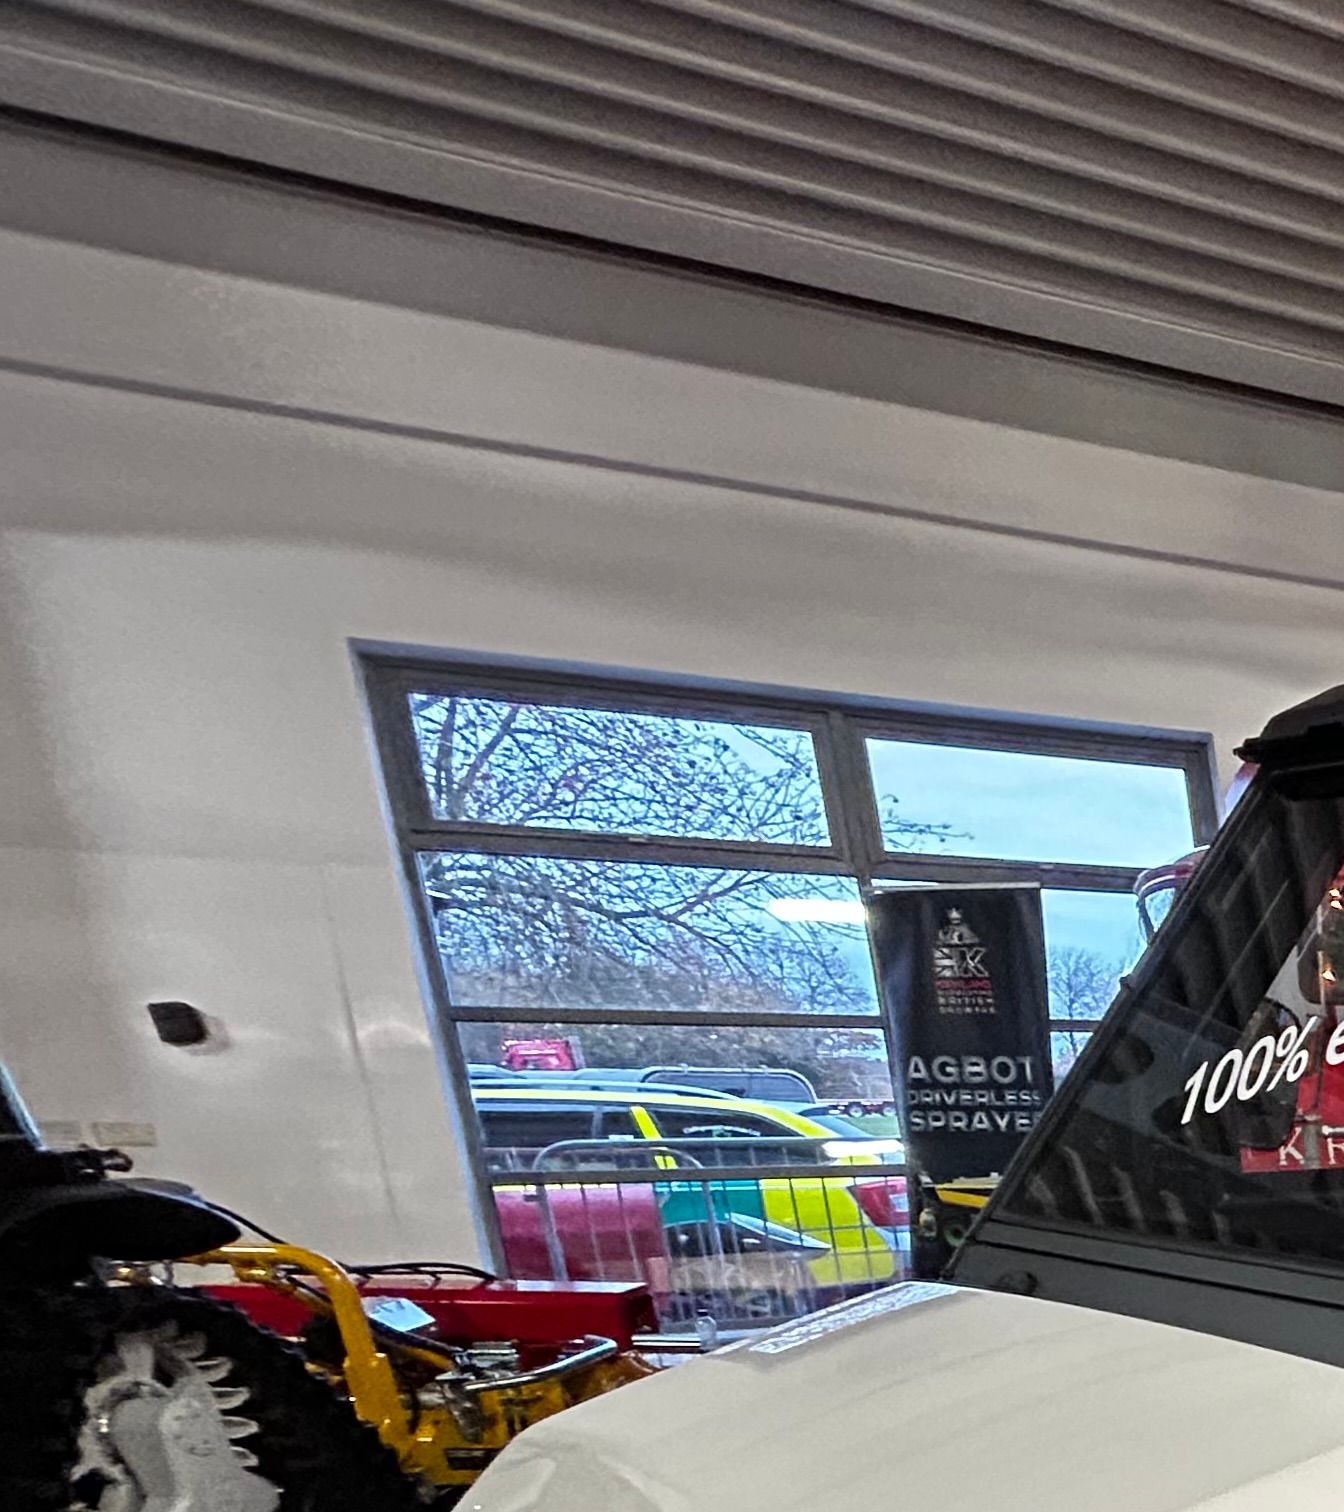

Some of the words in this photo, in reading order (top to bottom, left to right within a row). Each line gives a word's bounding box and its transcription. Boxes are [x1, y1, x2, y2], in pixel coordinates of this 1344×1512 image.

[907, 1054, 1034, 1085] AGBOT
[1179, 1014, 1319, 1126] 100%
[907, 1088, 1042, 1107] DRIVERLESS
